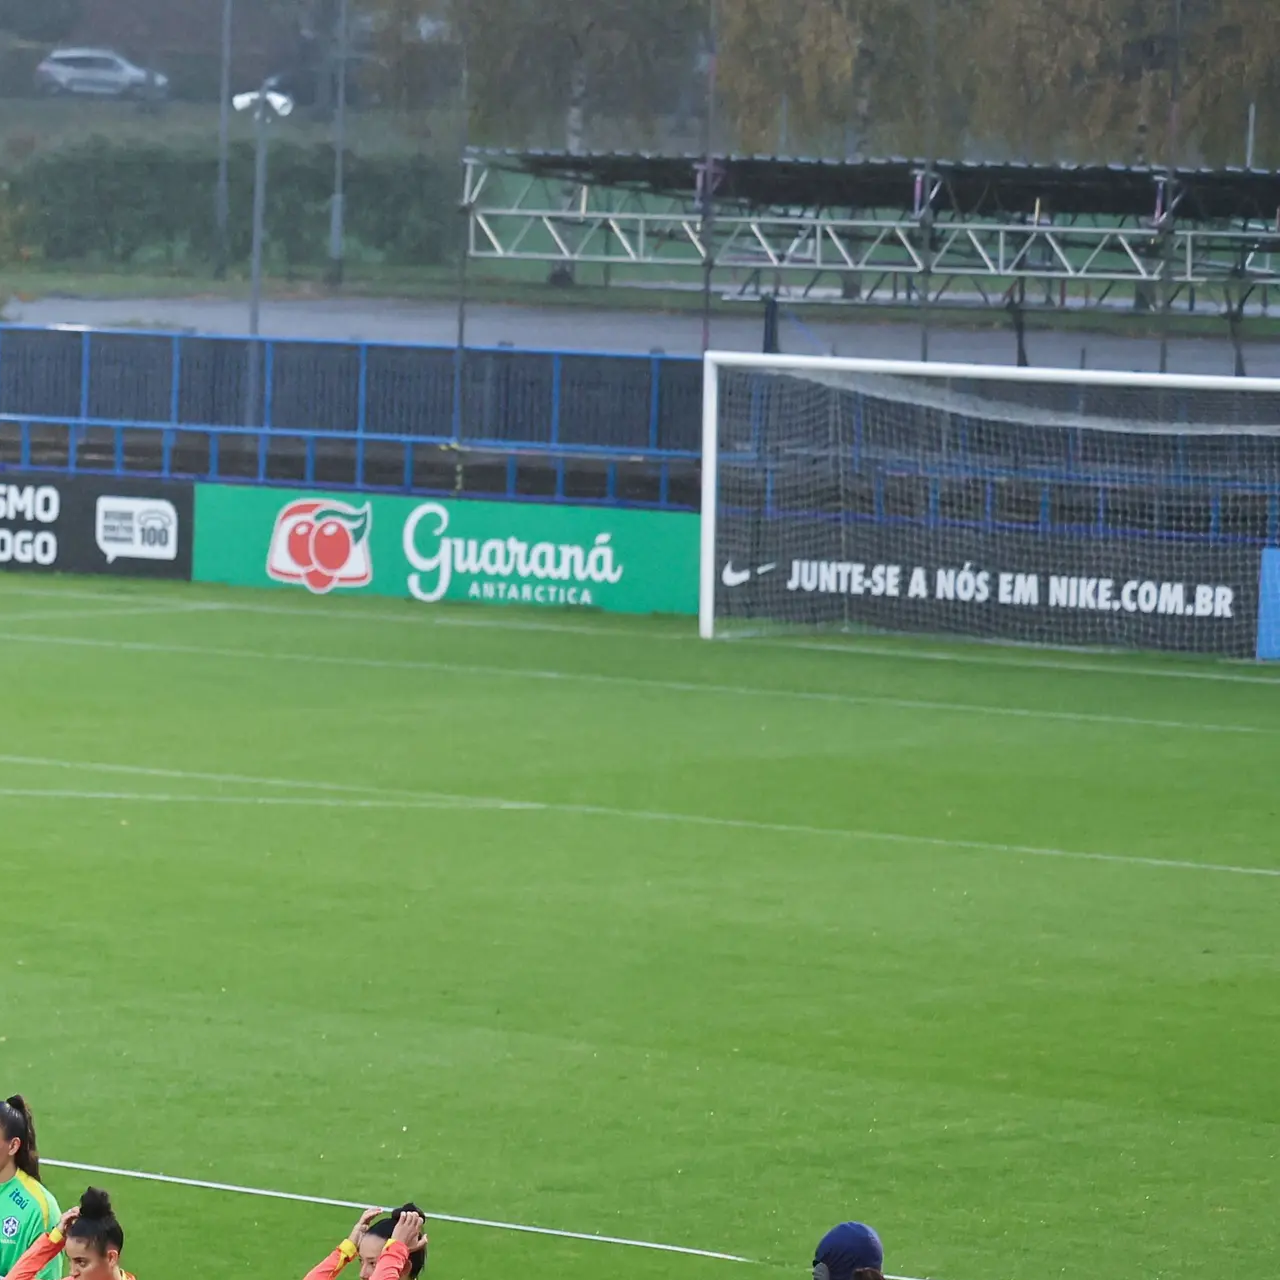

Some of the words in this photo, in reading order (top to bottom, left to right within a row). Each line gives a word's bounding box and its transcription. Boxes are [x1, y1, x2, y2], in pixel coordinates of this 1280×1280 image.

[140, 526, 169, 547] 100
[403, 501, 624, 603] Guaraná
[468, 581, 594, 606] ANTARCTICA
[786, 559, 901, 599] JUNTE-SE
[908, 566, 928, 599] A
[938, 561, 990, 603] NÓS
[998, 573, 1040, 606] EM
[1048, 575, 1234, 619] NIKE.COM.BR
[9, 1187, 30, 1210] itaú
